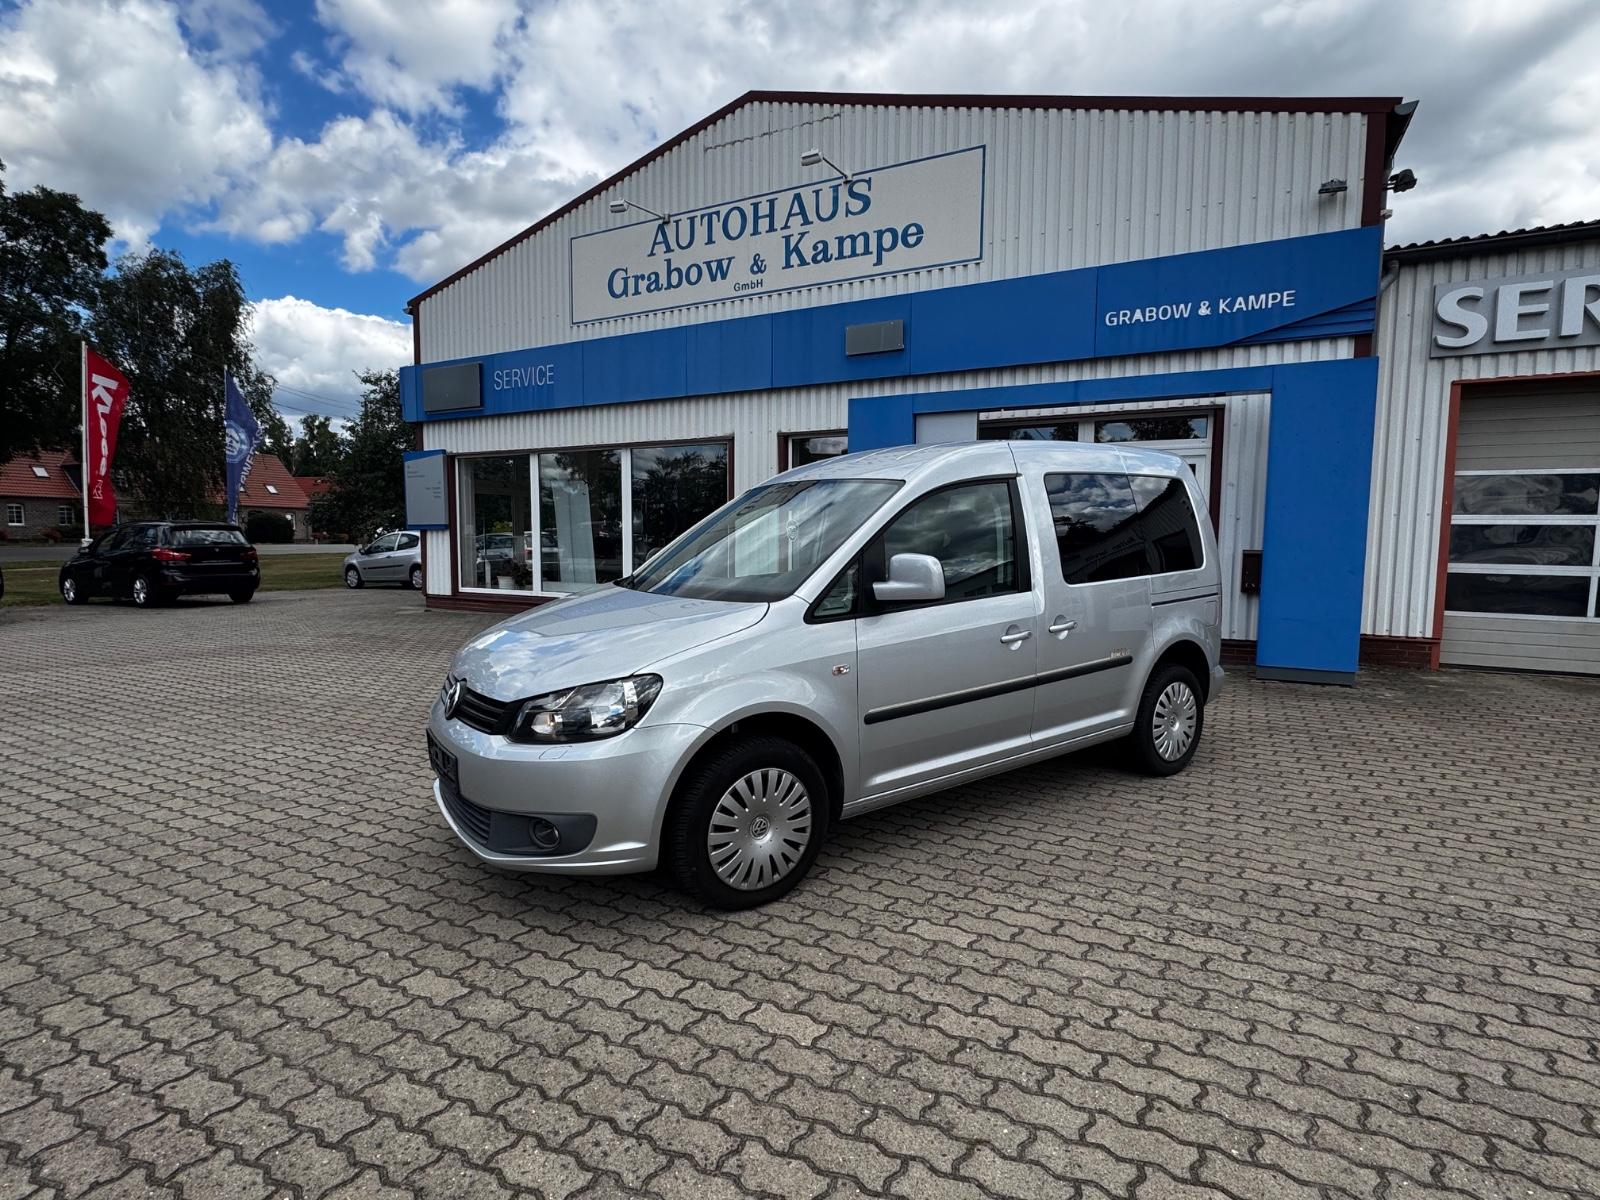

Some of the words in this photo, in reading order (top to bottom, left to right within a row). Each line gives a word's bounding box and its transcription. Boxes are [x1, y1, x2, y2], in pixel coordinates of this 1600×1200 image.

[647, 177, 873, 257] AUTOHAUS
[607, 256, 736, 300] Grabow
[749, 253, 767, 275] &
[781, 221, 925, 271] Kampe
[733, 278, 764, 293] GmbH
[1104, 301, 1192, 328] GRABOW
[1197, 299, 1212, 317] &
[1218, 289, 1296, 314] KAMPE
[493, 364, 555, 391] SERVICE
